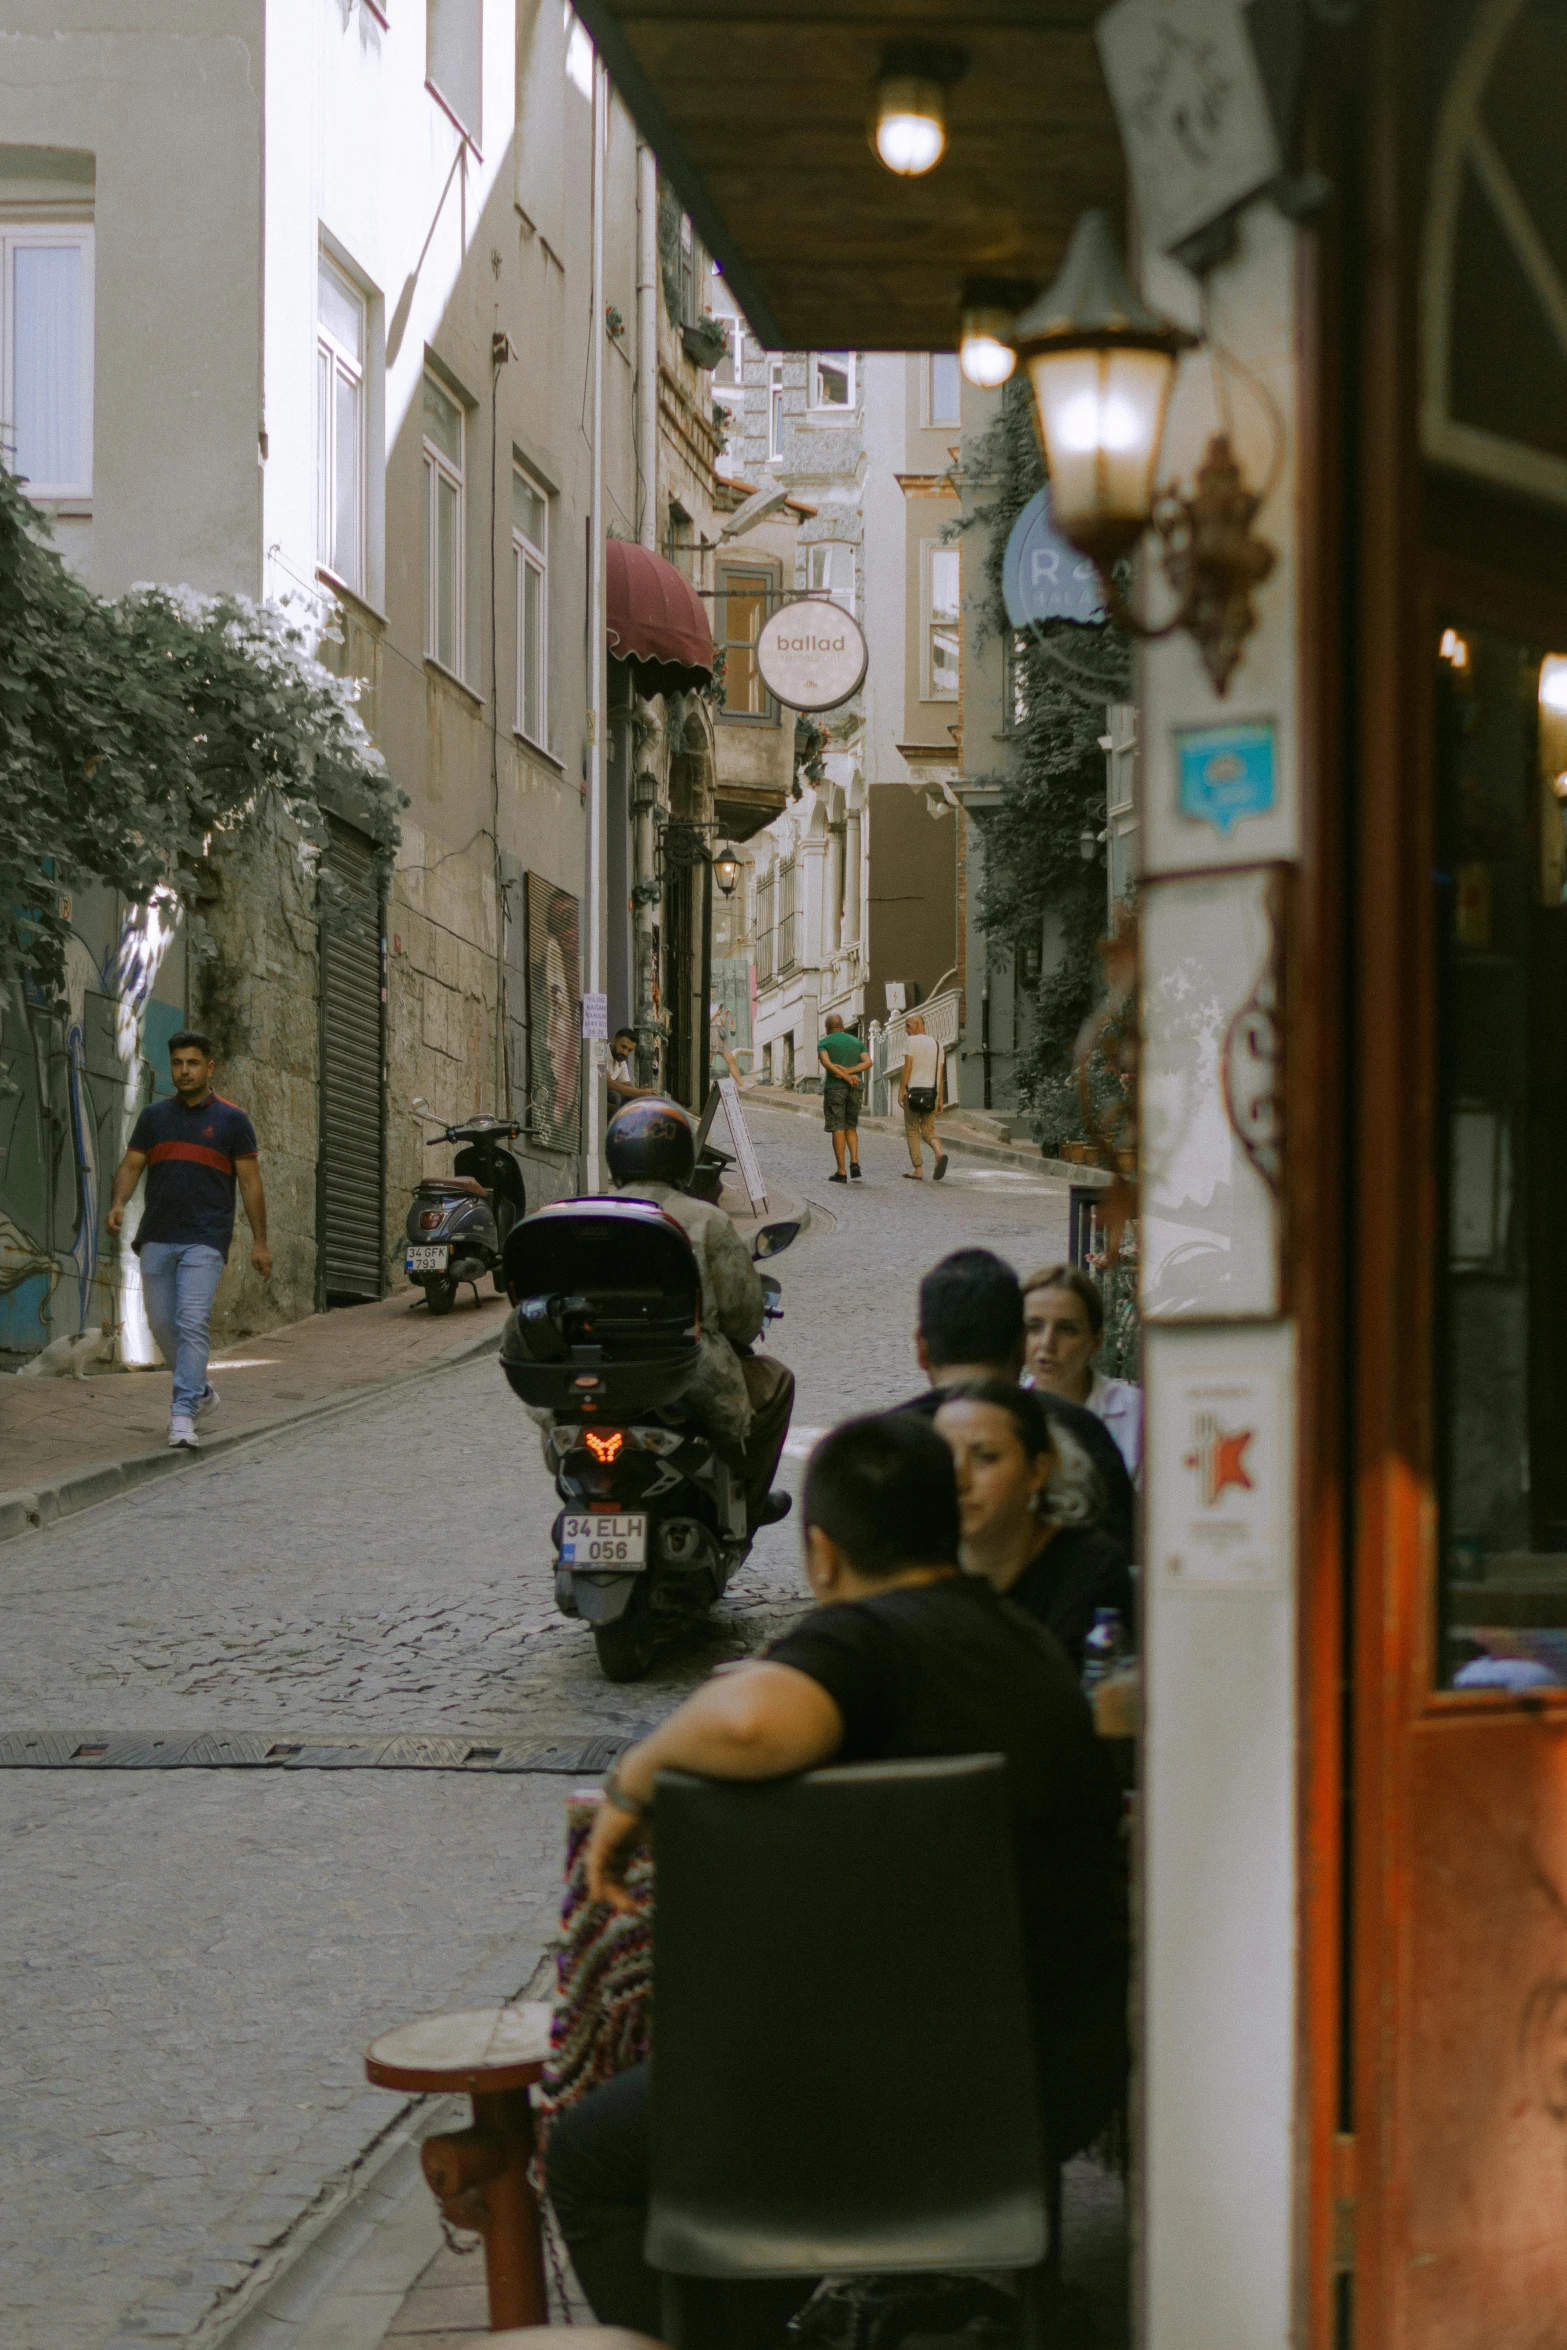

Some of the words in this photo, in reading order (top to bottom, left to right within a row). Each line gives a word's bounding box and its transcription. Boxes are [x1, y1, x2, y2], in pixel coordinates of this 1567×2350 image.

[777, 635, 844, 651] ballad
[409, 1248, 421, 1258] 34
[425, 1247, 445, 1257] GFK
[416, 1259, 435, 1269] 793
[567, 1519, 591, 1537] 34
[597, 1519, 642, 1537] ELH
[589, 1541, 627, 1560] 056
